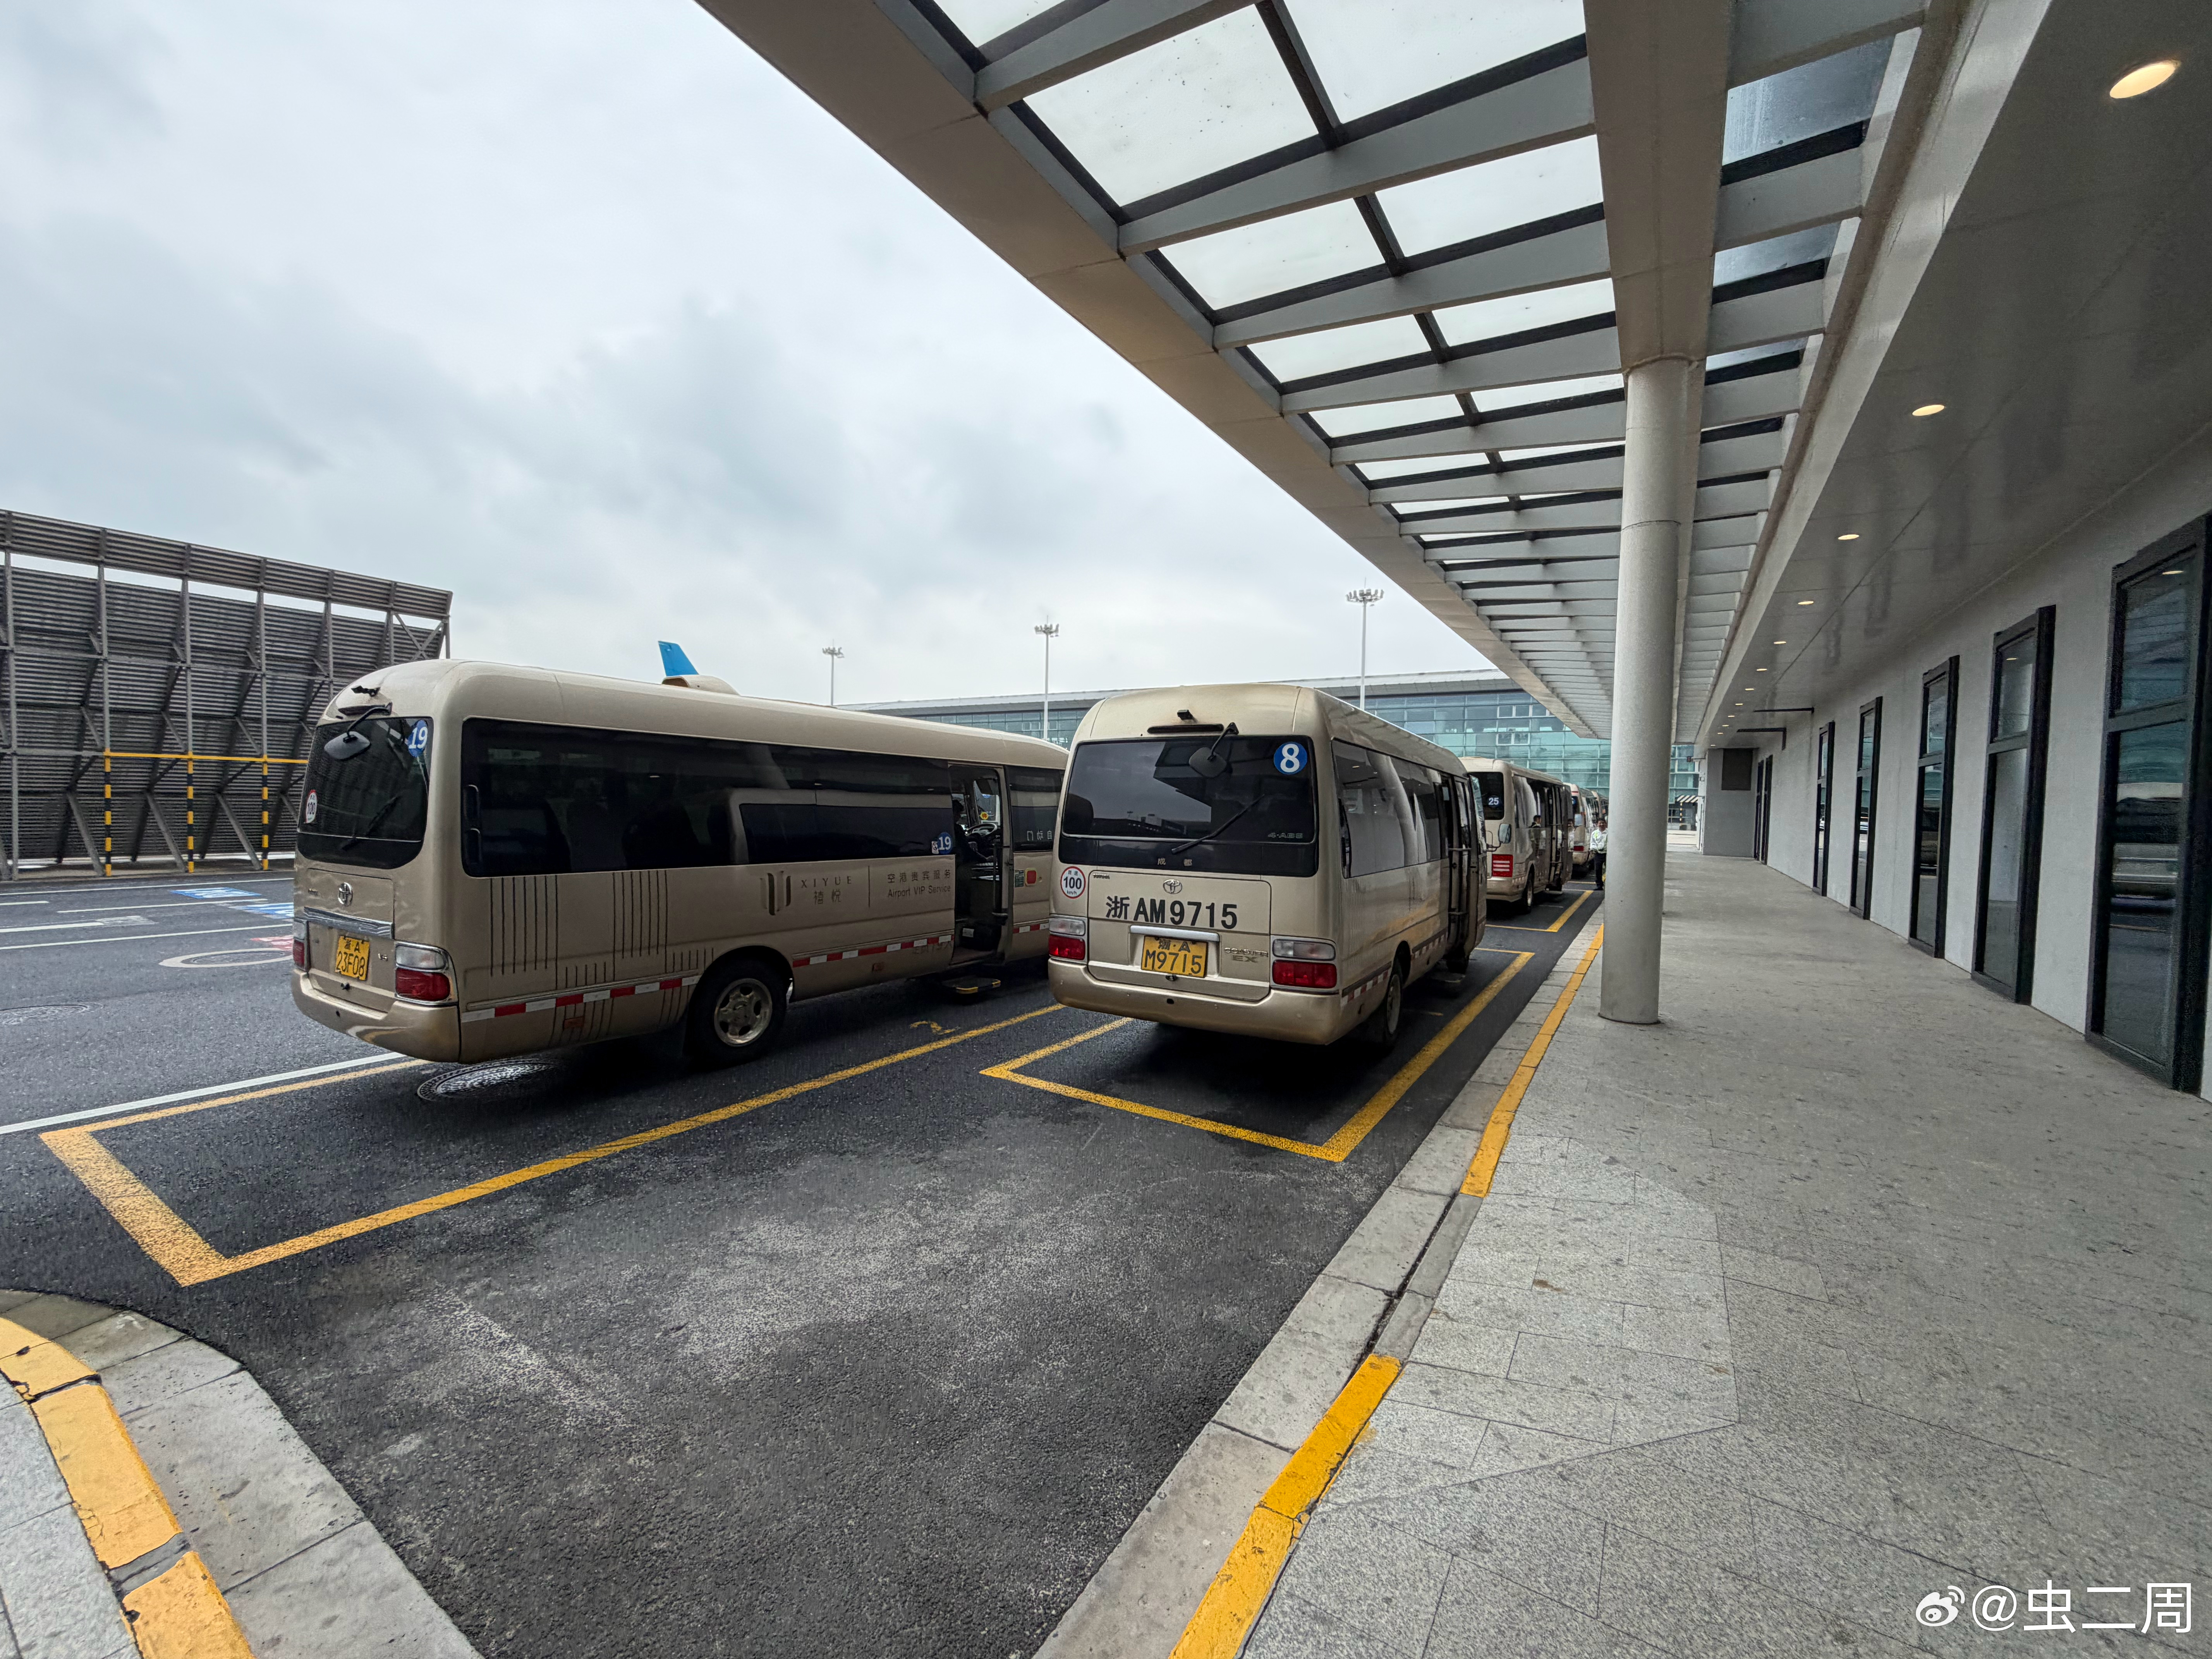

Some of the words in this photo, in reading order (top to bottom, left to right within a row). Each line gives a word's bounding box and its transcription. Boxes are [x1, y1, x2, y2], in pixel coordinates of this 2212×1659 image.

[408, 726, 428, 749] 19
[1280, 744, 1300, 773] 8
[939, 836, 951, 850] 19
[888, 888, 910, 899] Airport
[914, 886, 925, 895] VIP
[928, 885, 950, 893] Service
[1063, 876, 1082, 890] 100
[336, 951, 365, 977] 23F08
[1144, 949, 1202, 974] M9715
